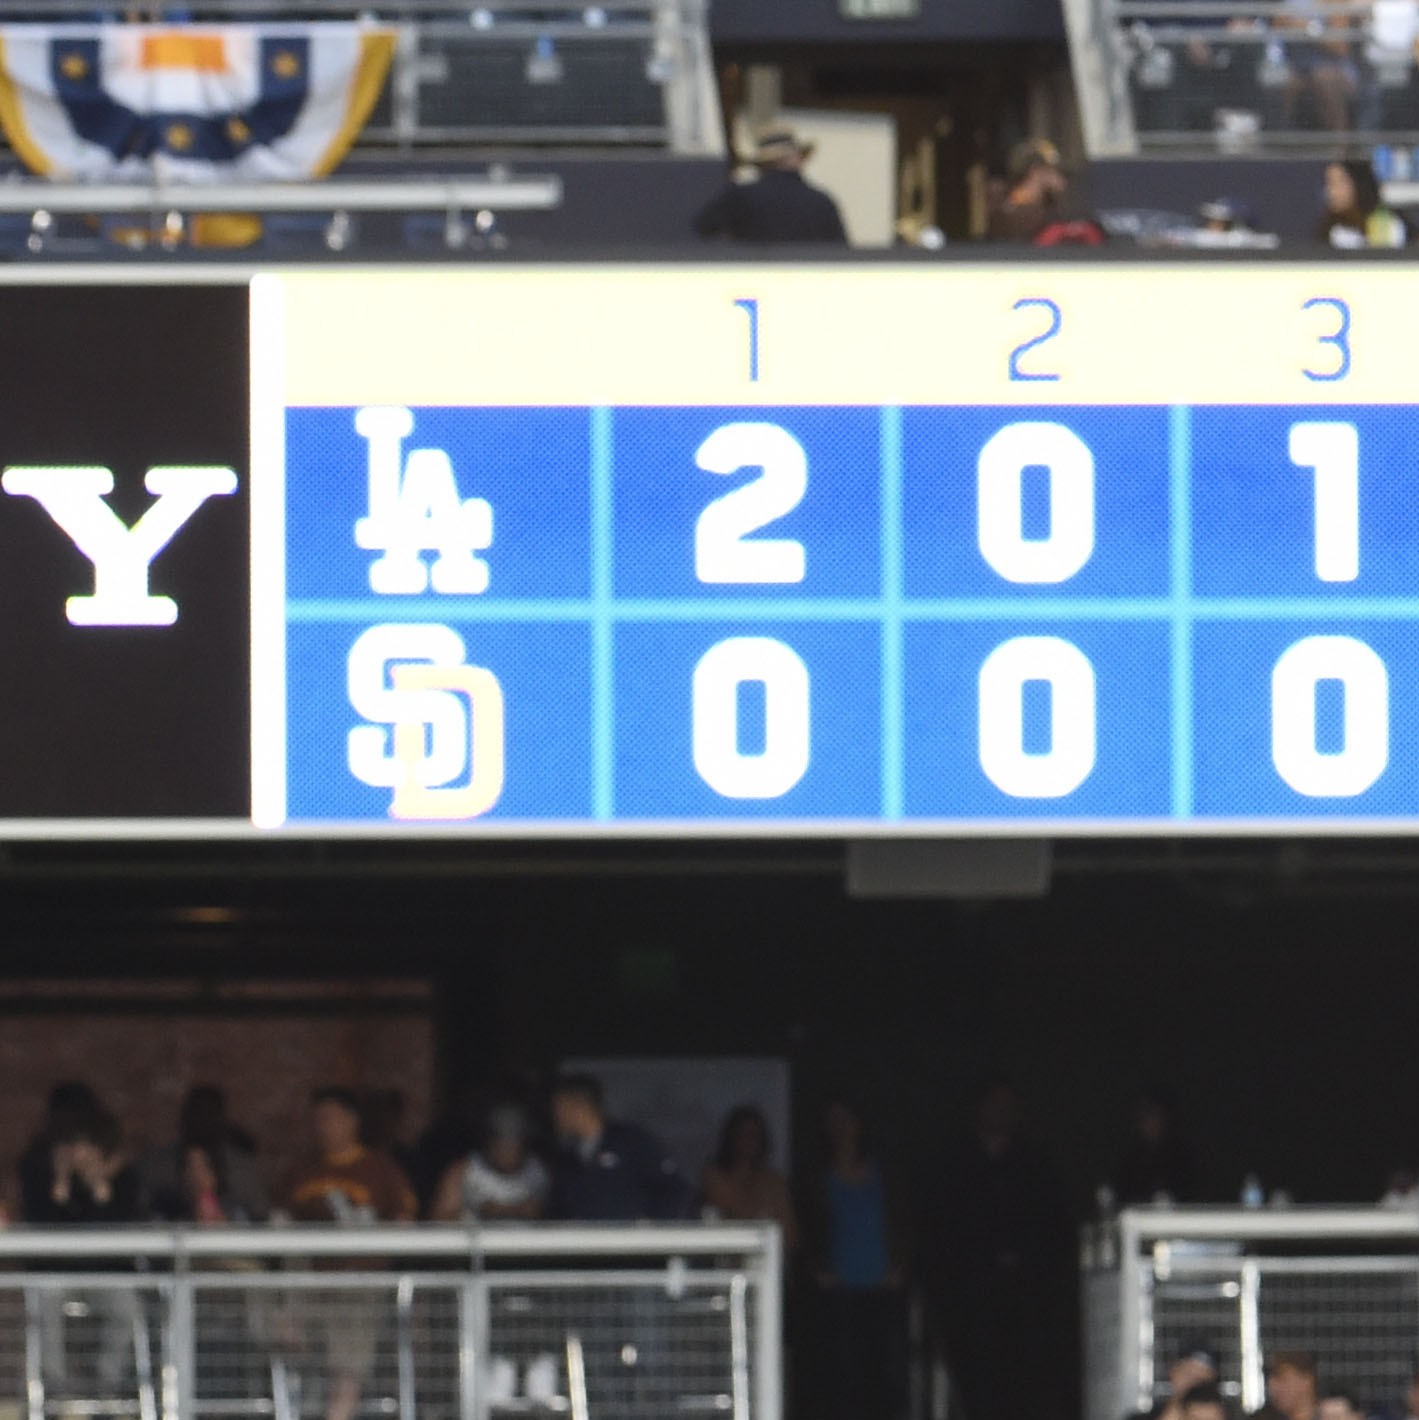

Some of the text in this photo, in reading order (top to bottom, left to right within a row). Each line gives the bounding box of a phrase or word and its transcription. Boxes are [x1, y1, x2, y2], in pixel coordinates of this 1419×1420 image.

[732, 298, 760, 383] 1
[1007, 297, 1063, 384] 2
[1301, 296, 1352, 384] 3
[0, 465, 238, 627] Y
[354, 405, 494, 595] LA
[695, 422, 807, 584] 2
[977, 421, 1095, 584] 0
[1289, 422, 1359, 583] 1
[692, 637, 810, 799] 0
[978, 636, 1096, 799] 0
[1271, 635, 1389, 798] 0
